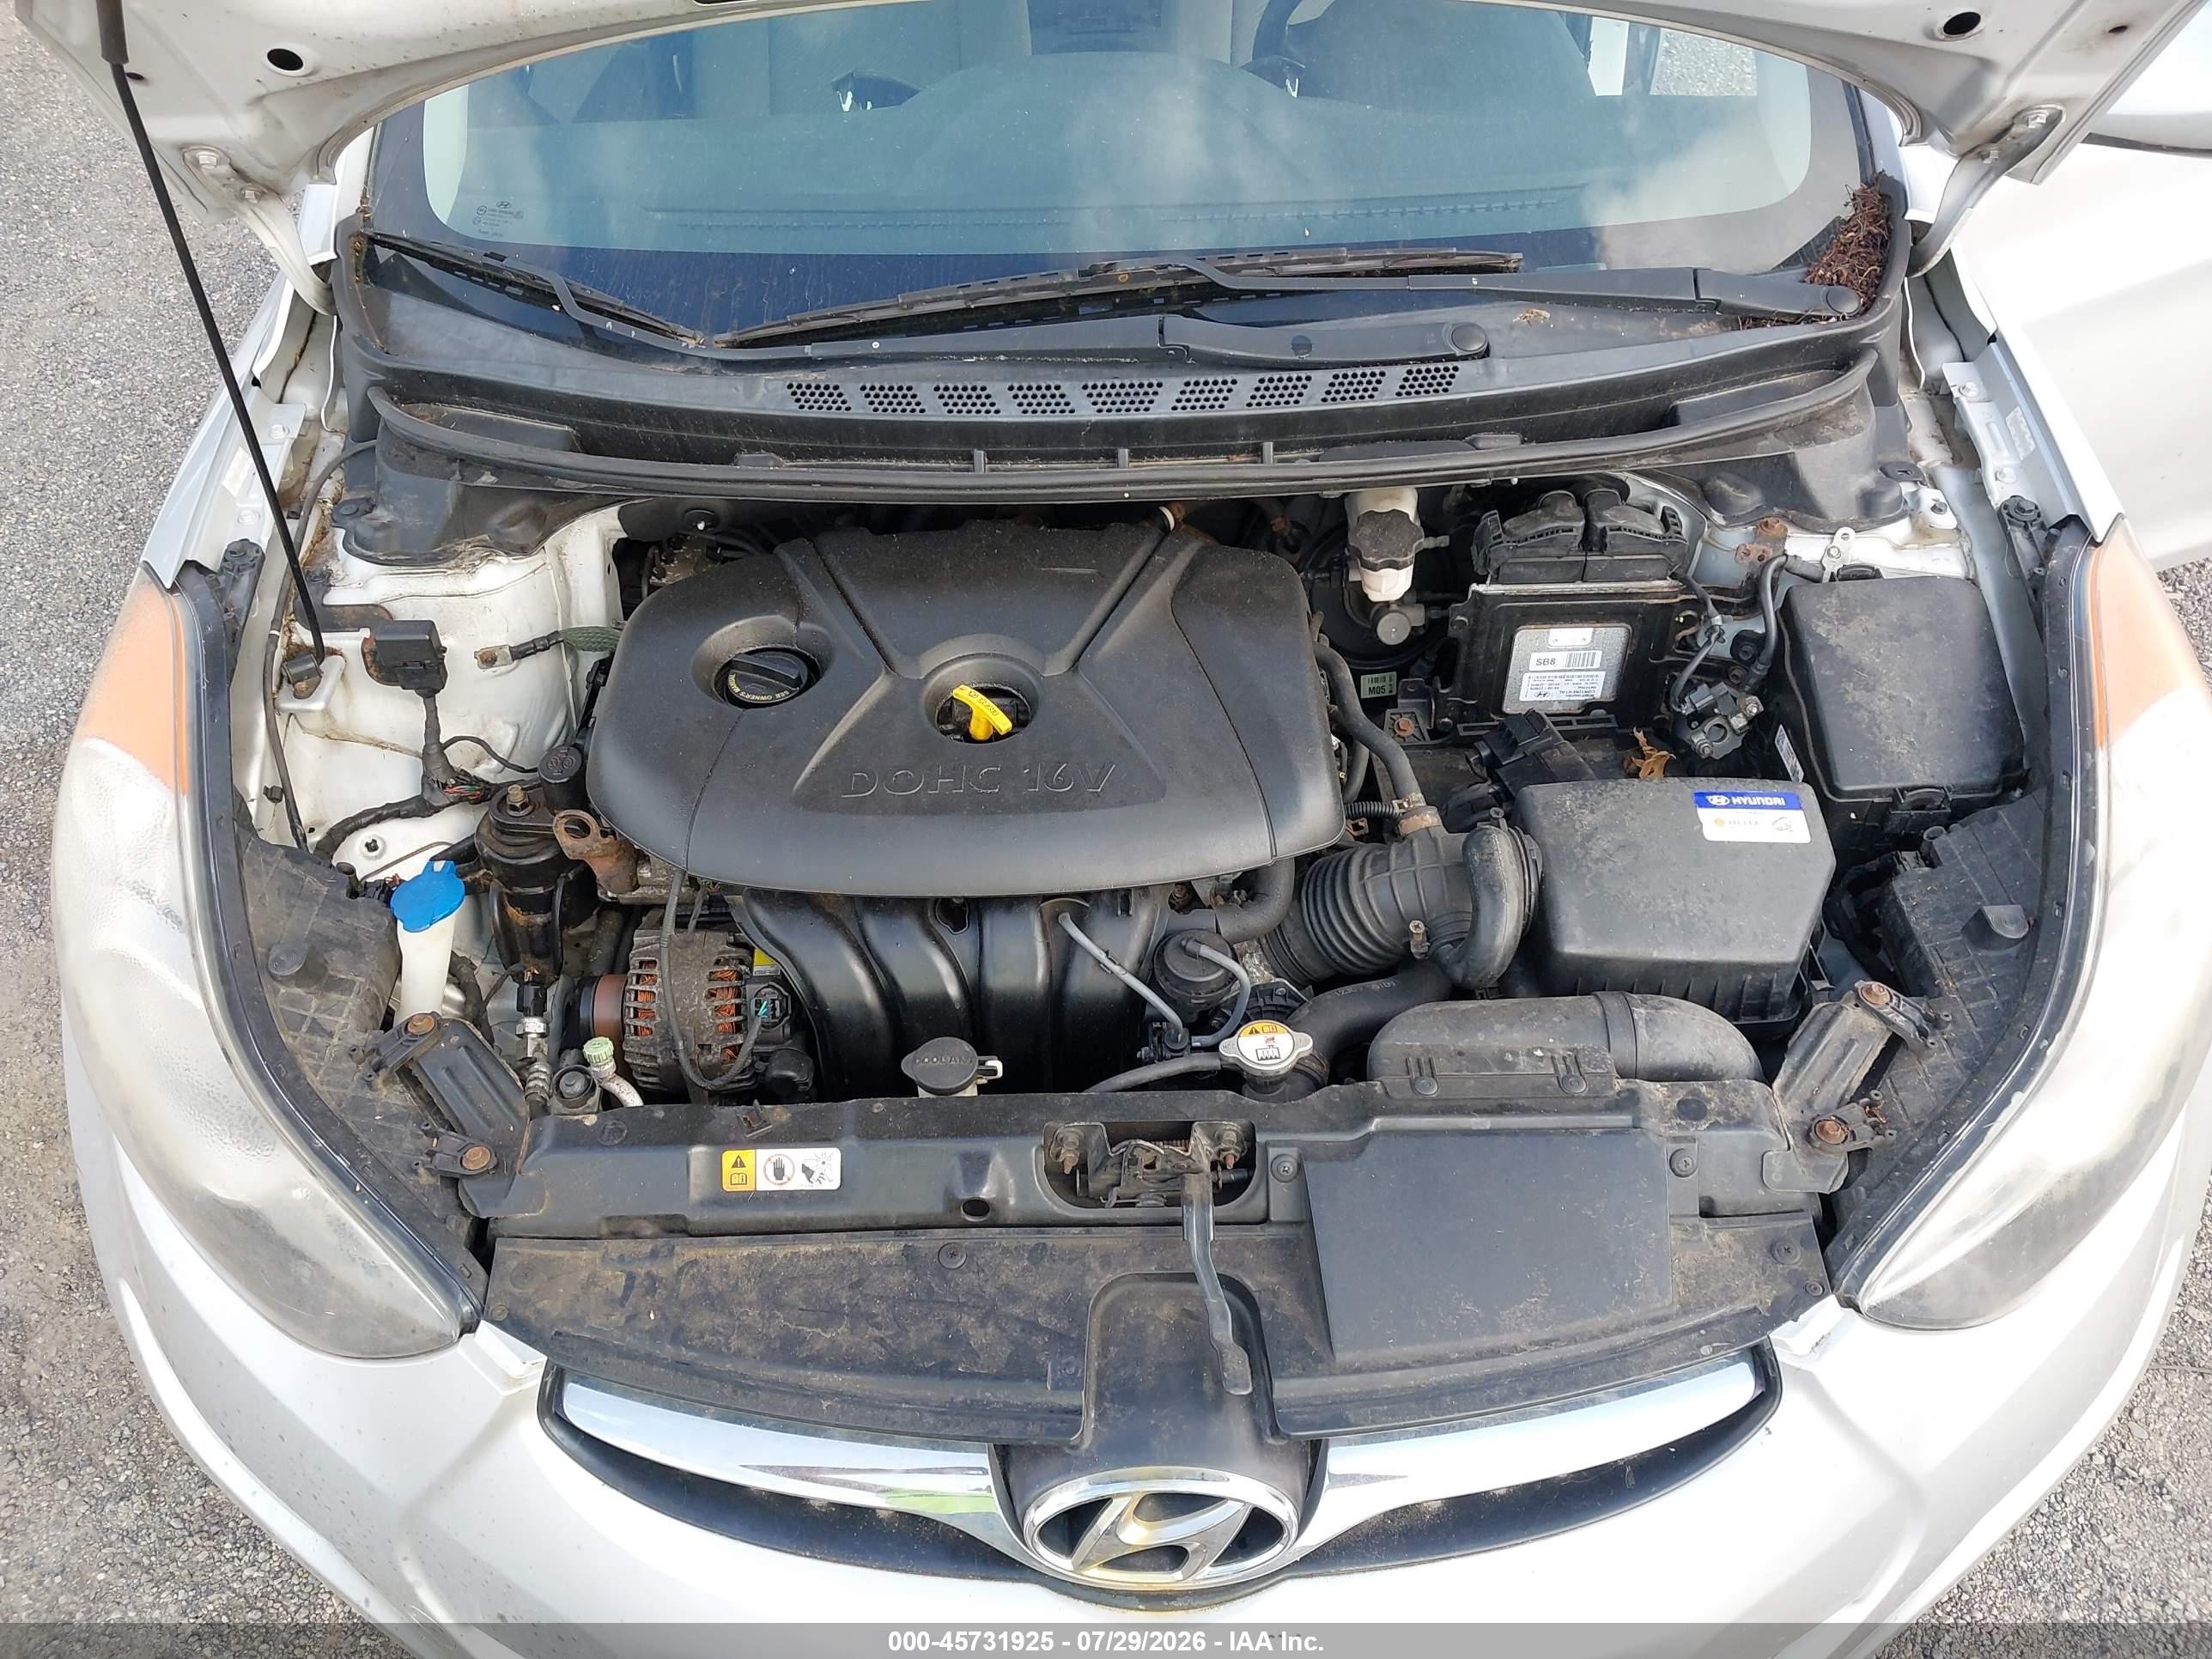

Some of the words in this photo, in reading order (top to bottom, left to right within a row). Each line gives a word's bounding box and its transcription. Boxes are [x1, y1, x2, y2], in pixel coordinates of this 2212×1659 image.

[1535, 658, 1557, 666] SB8
[775, 690, 790, 699] SEE
[1368, 685, 1386, 695] M05
[842, 763, 1002, 798] DOHC
[1023, 762, 1116, 793] 16V
[1731, 796, 1786, 806] HYUNDAI
